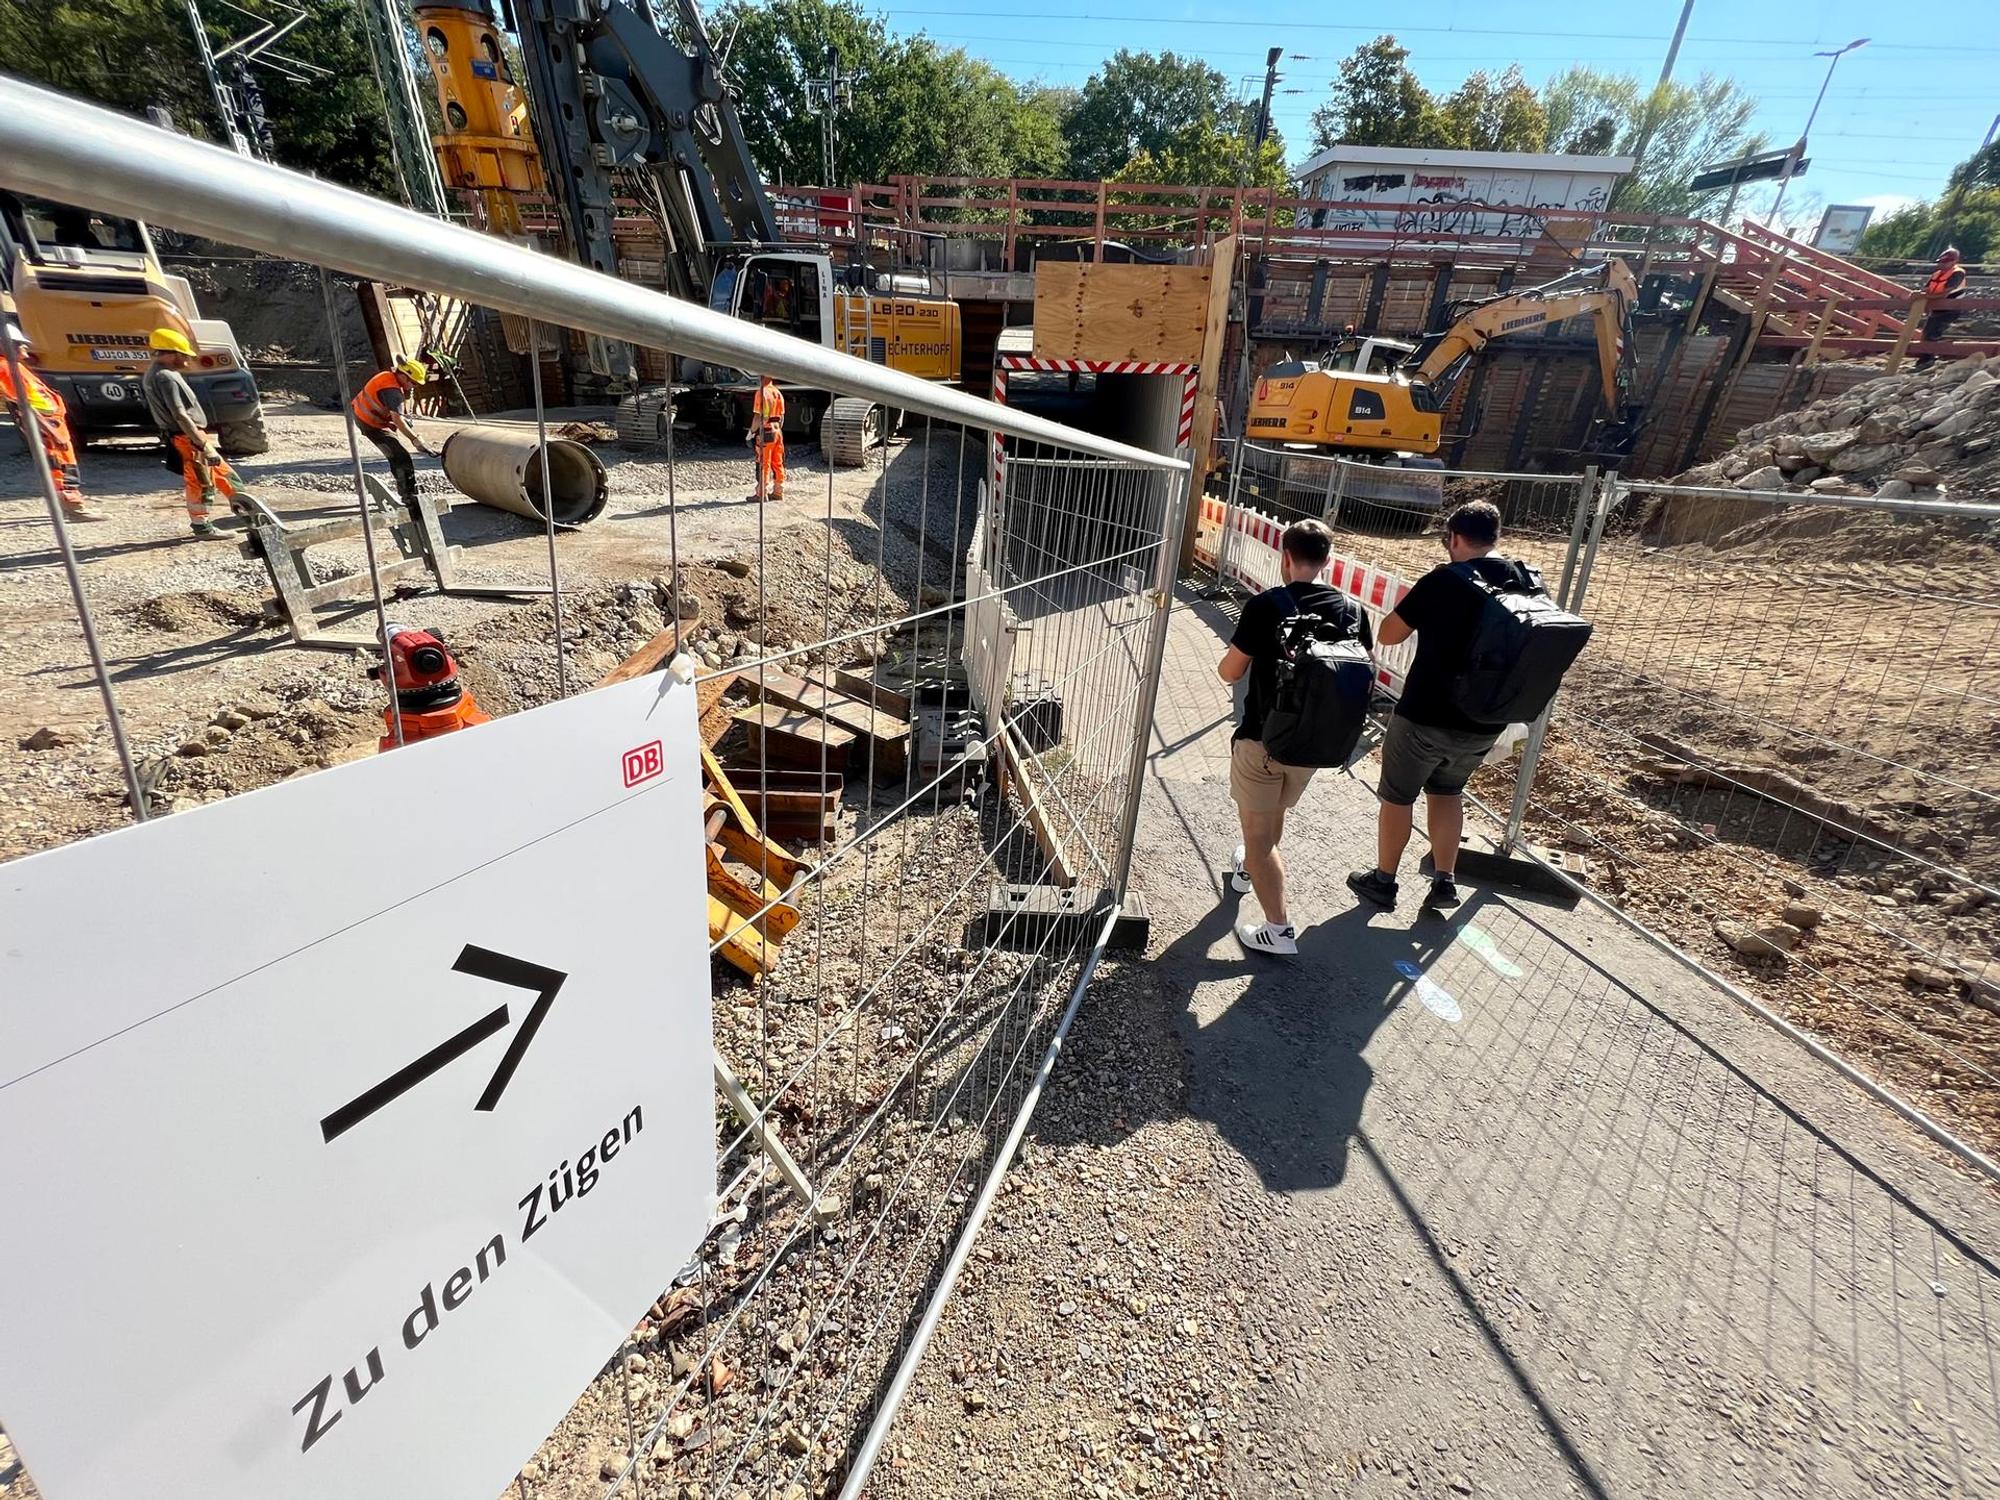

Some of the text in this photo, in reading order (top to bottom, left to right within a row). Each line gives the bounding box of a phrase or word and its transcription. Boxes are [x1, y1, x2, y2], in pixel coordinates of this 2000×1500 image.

[1501, 312, 1547, 331] LIEBHERR
[888, 343, 950, 356] ECHTERHOFF
[106, 386, 121, 398] 40
[1280, 382, 1295, 390] 914
[1354, 406, 1371, 415] 914
[626, 746, 660, 782] DB
[292, 1105, 643, 1454] Zu den Zügen
